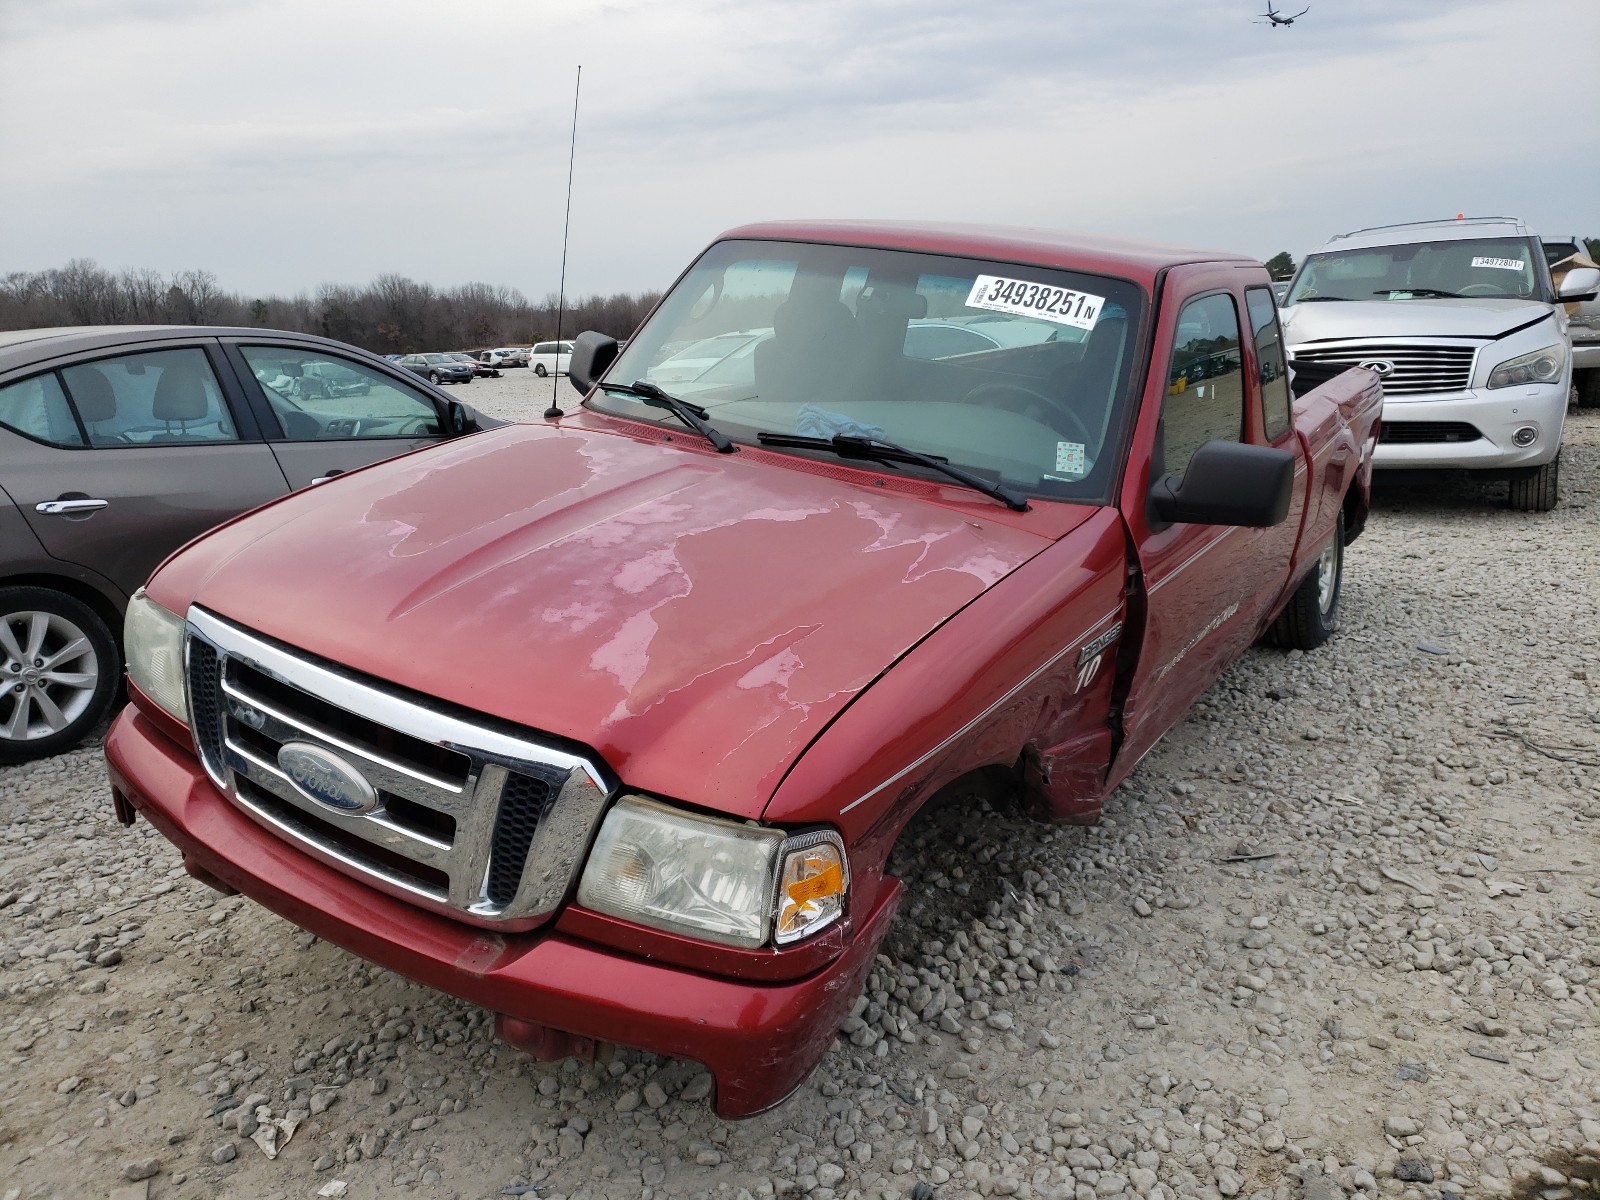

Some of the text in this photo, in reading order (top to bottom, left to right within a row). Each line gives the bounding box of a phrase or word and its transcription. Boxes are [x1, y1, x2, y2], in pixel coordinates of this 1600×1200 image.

[988, 279, 1087, 318] 34938251
[1084, 306, 1096, 319] N
[291, 754, 345, 800] Ford
